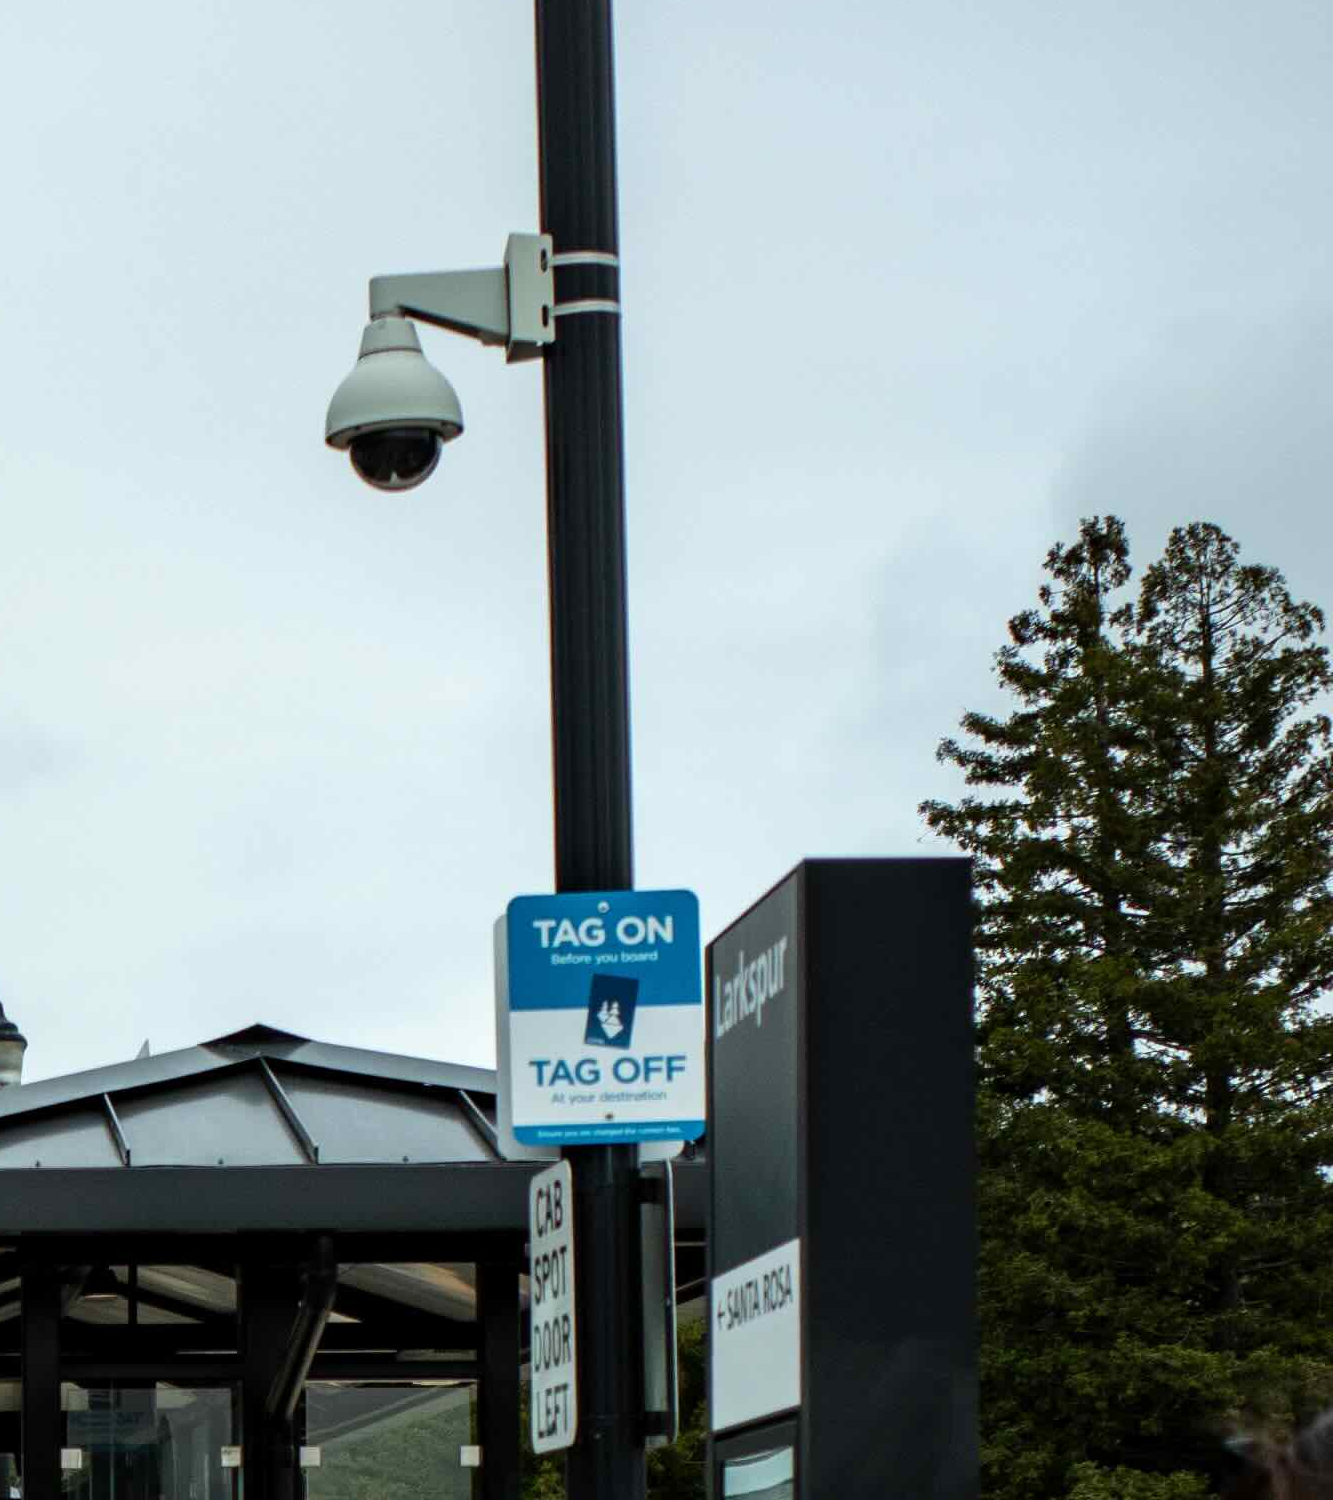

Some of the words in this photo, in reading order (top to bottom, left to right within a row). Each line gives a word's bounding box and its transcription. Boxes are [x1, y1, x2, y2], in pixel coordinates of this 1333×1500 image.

[533, 917, 606, 949] TAG
[616, 914, 674, 945] ON
[550, 951, 592, 966] Before
[595, 952, 619, 966] you
[621, 949, 659, 963] board
[714, 935, 788, 1040] Larkspur
[528, 1058, 601, 1087] TAG
[612, 1055, 687, 1085] OFF
[551, 1093, 567, 1105] At
[569, 1093, 596, 1107] your
[599, 1090, 667, 1104] destination
[536, 1179, 563, 1239] CAB
[534, 1245, 568, 1305] SPOT
[726, 1279, 761, 1331] SANTA
[763, 1263, 794, 1314] ROSA
[533, 1314, 571, 1373] DOOR
[536, 1382, 570, 1440] LEFT
